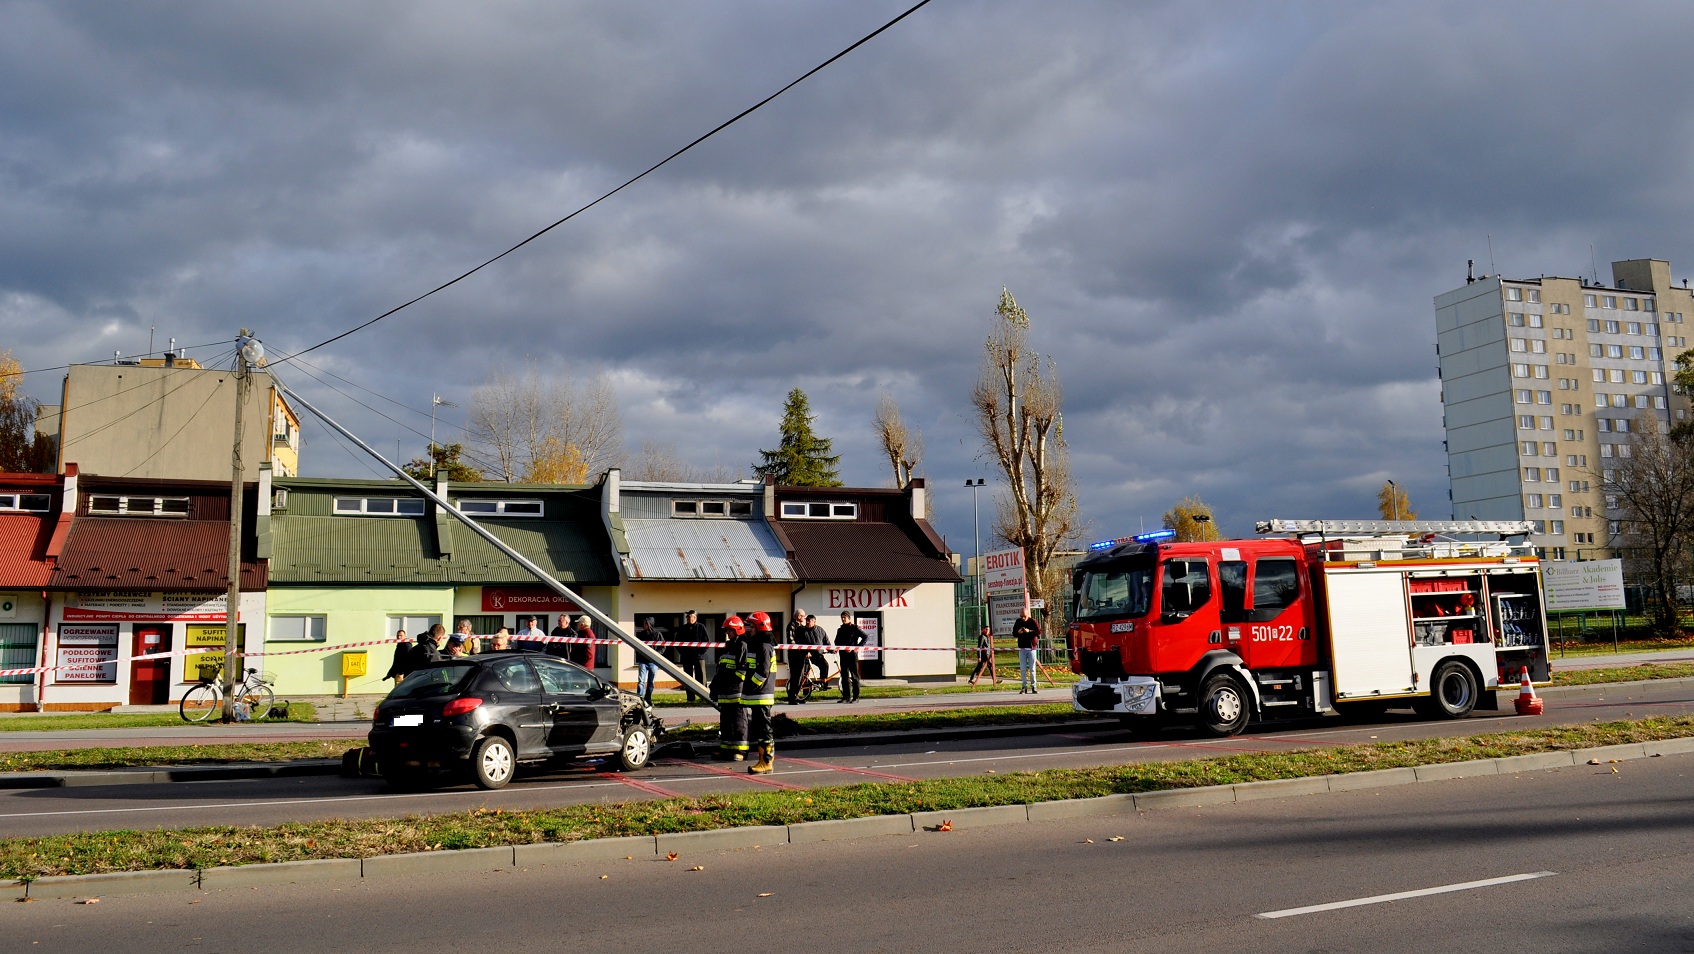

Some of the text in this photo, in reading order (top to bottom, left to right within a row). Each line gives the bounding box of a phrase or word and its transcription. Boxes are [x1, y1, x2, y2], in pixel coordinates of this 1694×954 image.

[986, 551, 1020, 570] EROTIK
[1582, 564, 1618, 574] Akademie
[1590, 575, 1606, 584] Jobs
[828, 588, 908, 608] EROTIK
